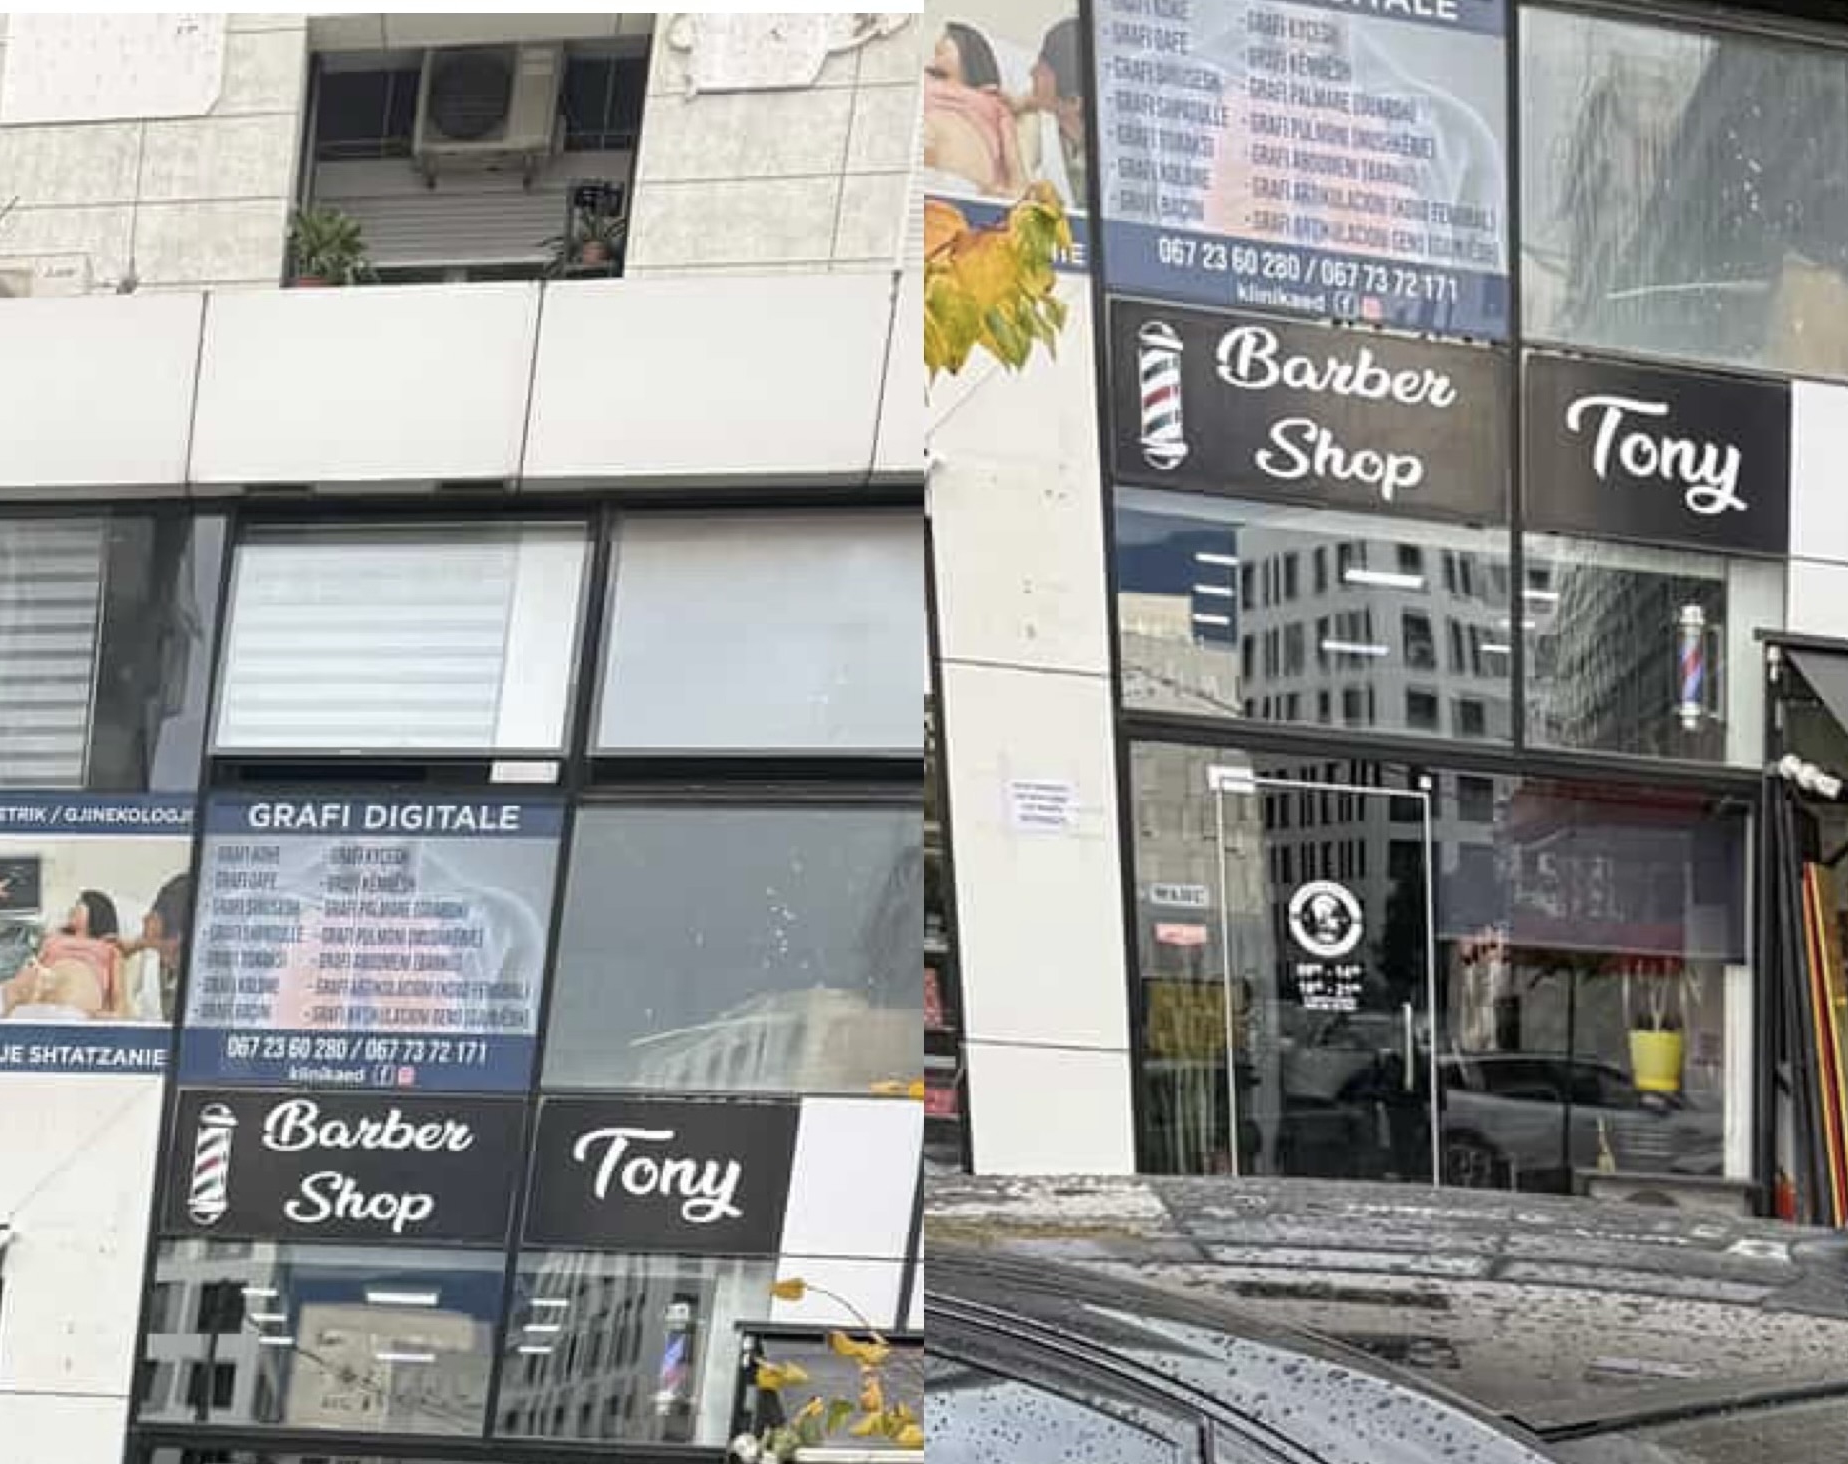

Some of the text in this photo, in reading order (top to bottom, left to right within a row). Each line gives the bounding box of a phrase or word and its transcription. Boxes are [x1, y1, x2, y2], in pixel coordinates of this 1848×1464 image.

[1159, 239, 1196, 266] 067
[1203, 242, 1227, 270] 23
[1232, 246, 1259, 274] 60
[1262, 252, 1300, 281] 280
[1321, 262, 1358, 288] 067
[1362, 267, 1388, 294] 73
[1394, 270, 1419, 298] 72
[1425, 275, 1458, 304] 171
[1216, 325, 1456, 409] Barber
[1257, 420, 1422, 500] Shop
[1566, 394, 1749, 514] Tony
[249, 802, 520, 830] GRAFI DIGITALE
[29, 1046, 171, 1066] SHTATZANIE
[227, 1036, 260, 1058] 067
[263, 1037, 285, 1058] 23
[364, 1039, 399, 1061] 067
[401, 1040, 426, 1062] 73
[428, 1040, 451, 1063] 72
[458, 1041, 486, 1065] 171
[262, 1100, 474, 1153] Barber
[283, 1170, 434, 1232] Shop
[572, 1127, 744, 1224] Tony
